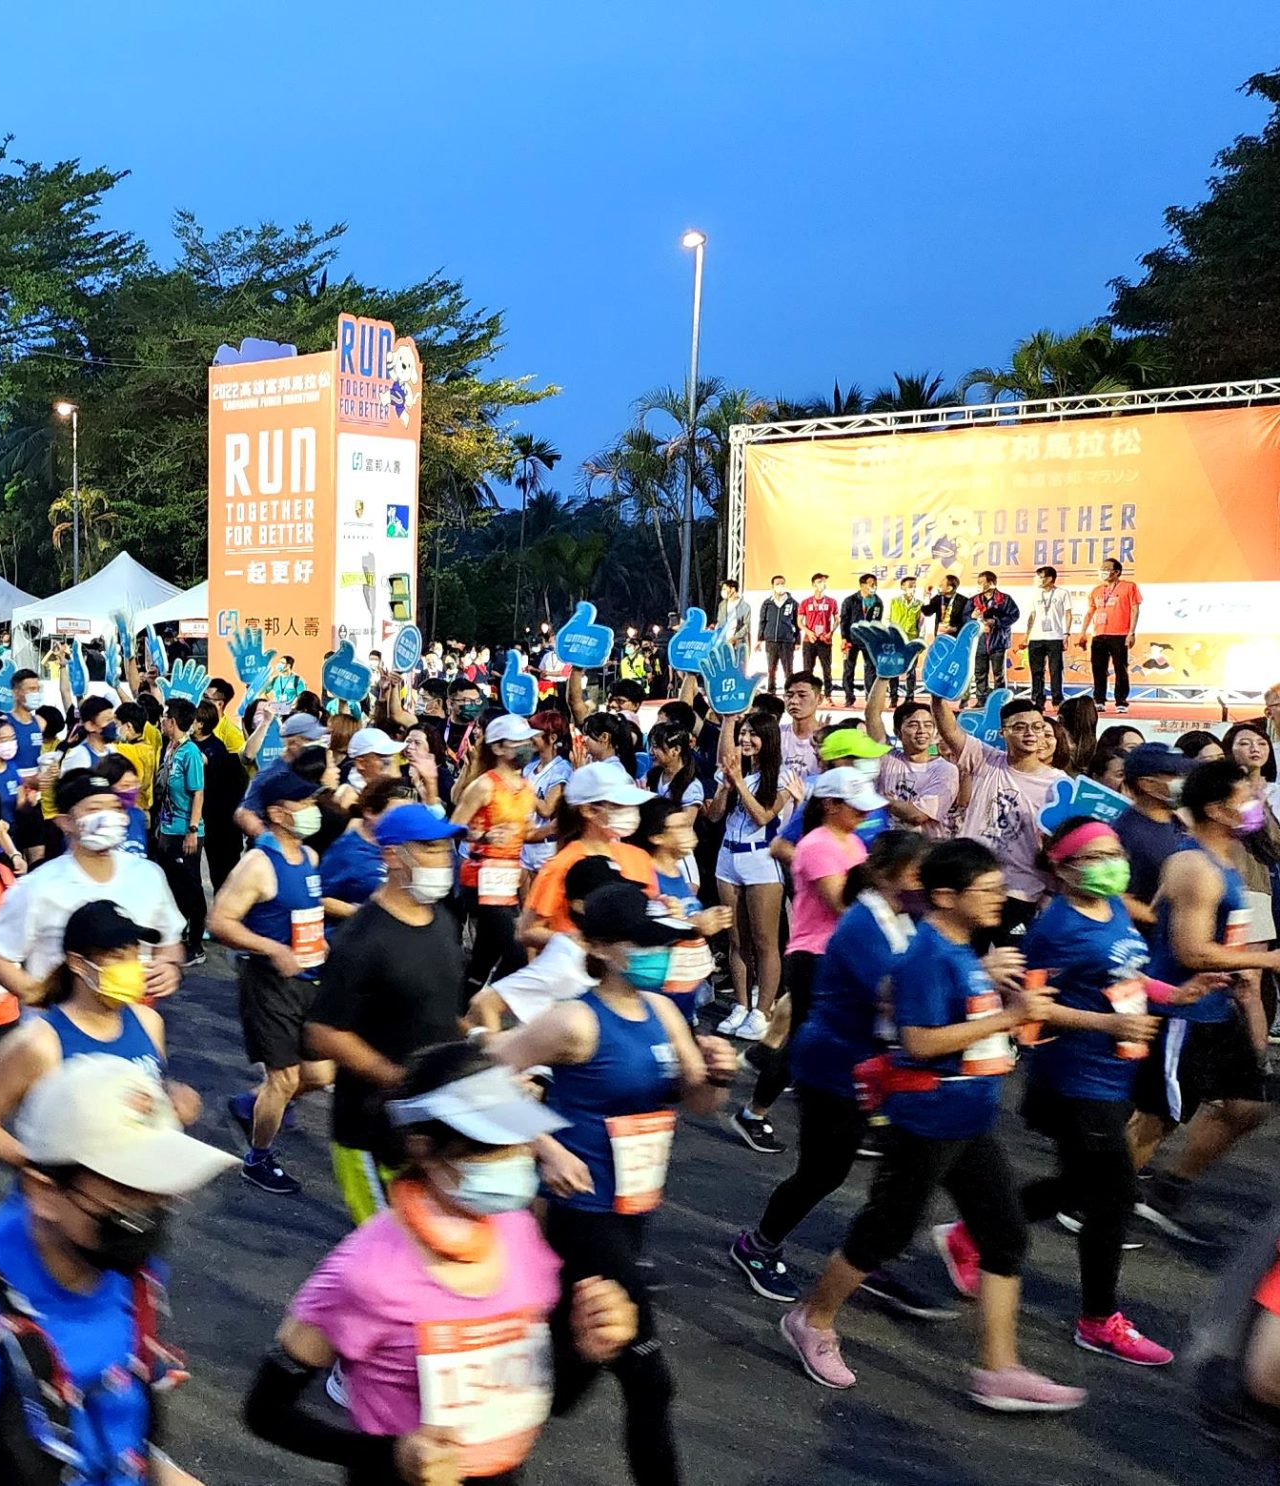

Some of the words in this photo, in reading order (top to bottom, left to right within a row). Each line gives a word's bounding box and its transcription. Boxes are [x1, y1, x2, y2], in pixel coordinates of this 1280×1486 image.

[340, 398, 355, 416] FOR
[359, 401, 389, 420] BETTER
[225, 427, 317, 497] RUN
[225, 498, 314, 523] TOGETHER
[974, 503, 1137, 536] TOGETHER
[225, 525, 252, 546] FOR
[259, 522, 314, 545] BETTER
[1034, 535, 1136, 567] BETTER
[224, 560, 314, 585] 一起更好
